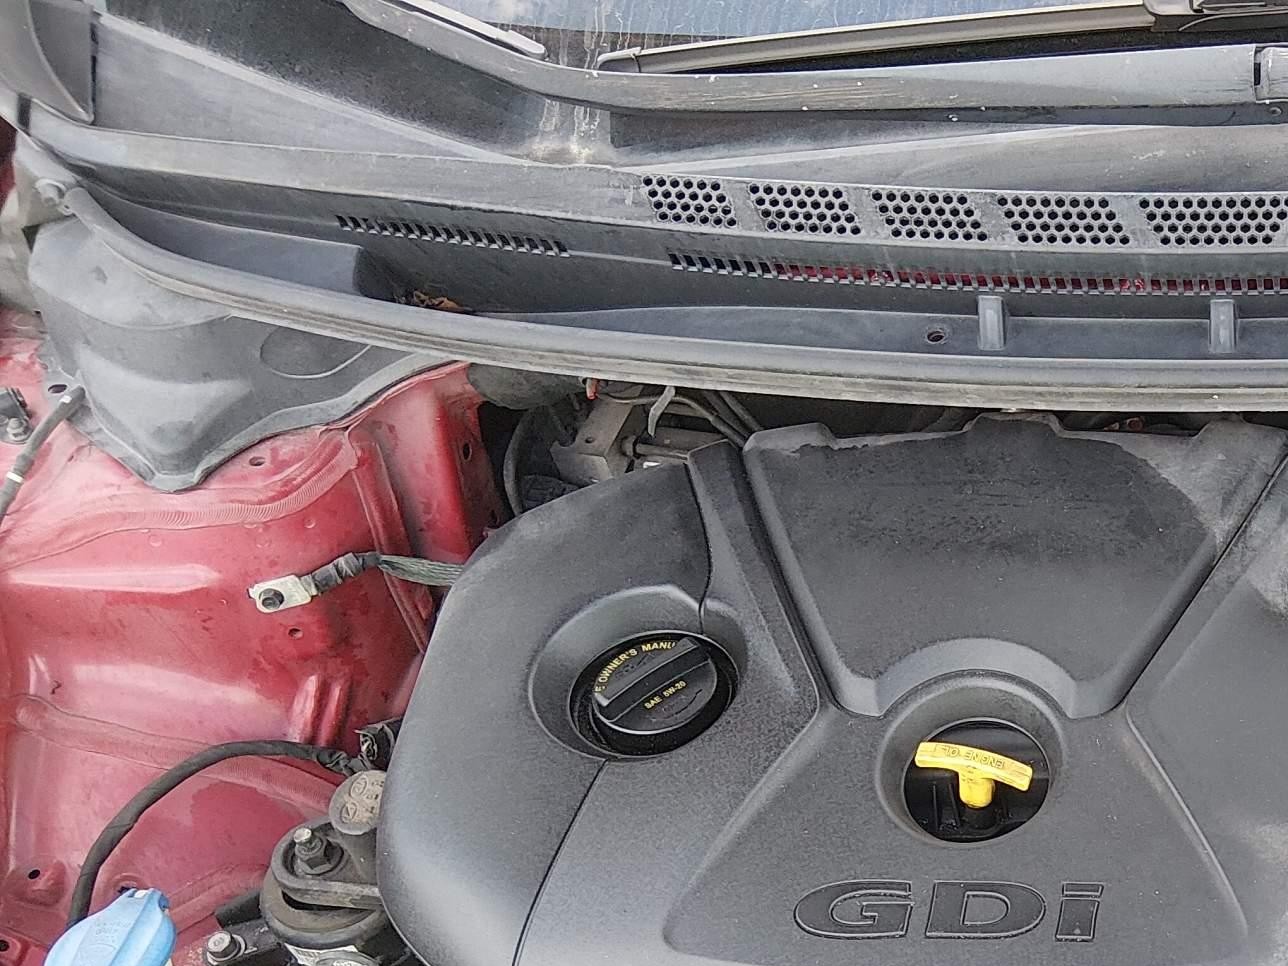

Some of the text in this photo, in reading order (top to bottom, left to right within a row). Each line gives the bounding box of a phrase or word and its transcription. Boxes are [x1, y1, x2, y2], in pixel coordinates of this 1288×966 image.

[598, 648, 637, 682] OWNER'S
[644, 695, 662, 709] SAE
[793, 879, 1104, 942] GDi
